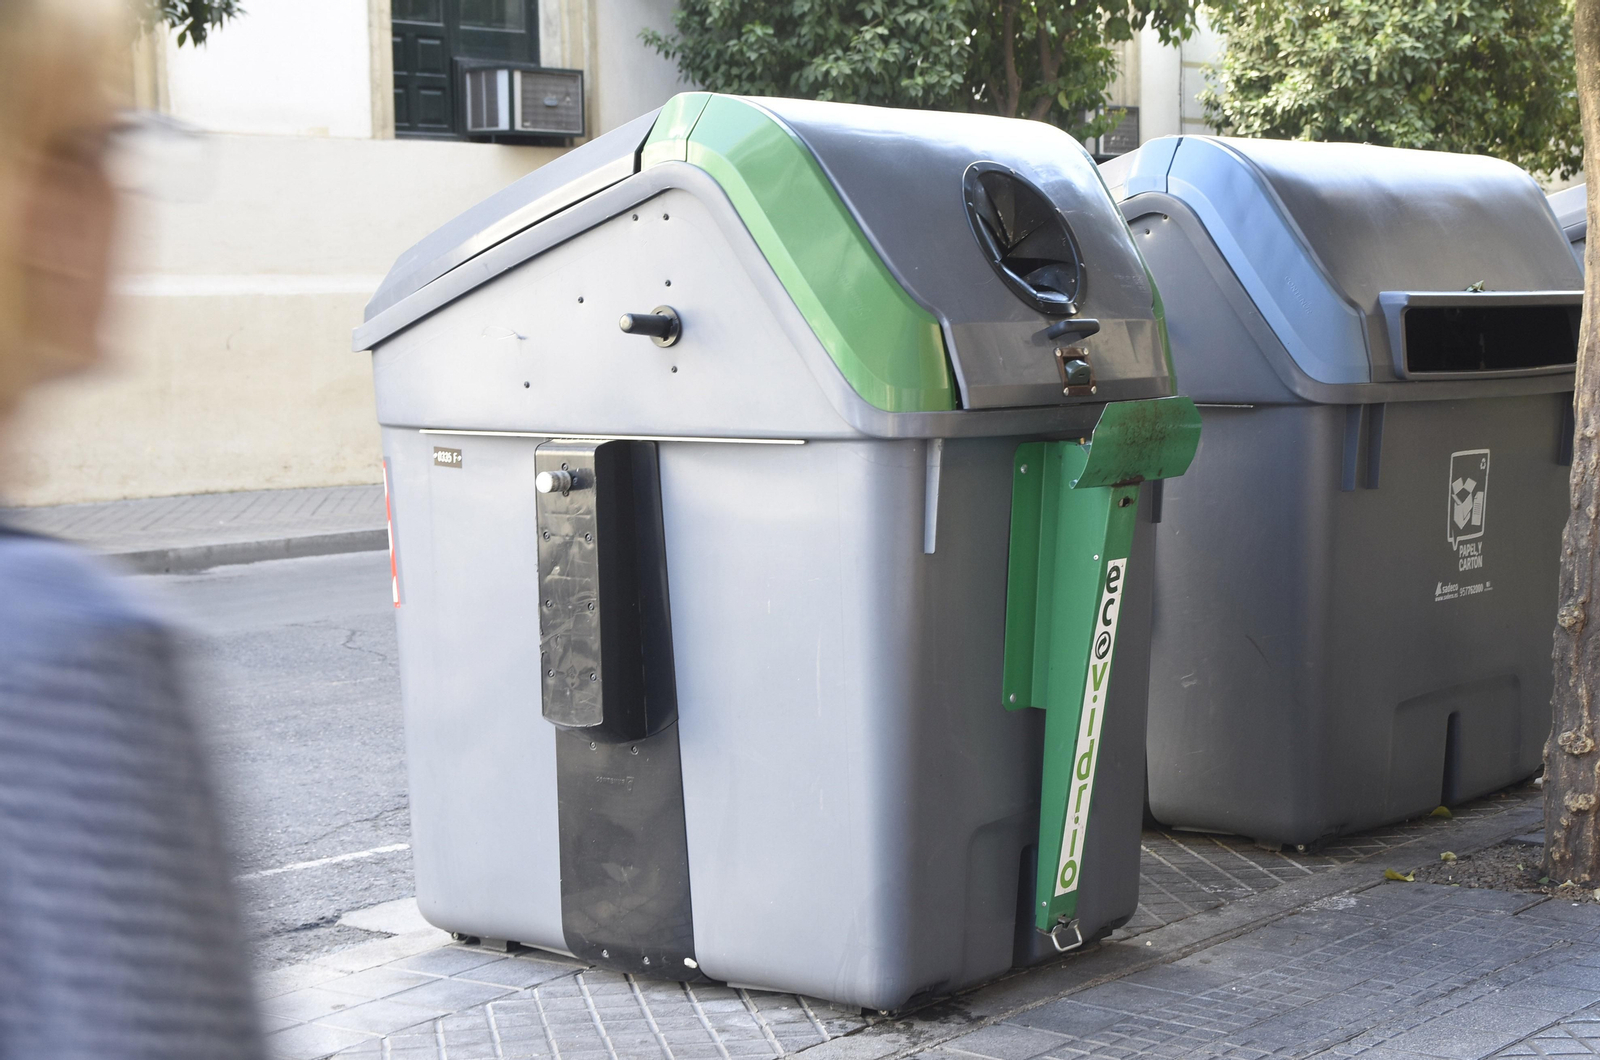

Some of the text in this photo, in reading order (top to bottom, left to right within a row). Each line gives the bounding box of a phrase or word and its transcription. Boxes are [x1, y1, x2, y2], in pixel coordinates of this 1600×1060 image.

[1459, 541, 1483, 558] PAPEL Y
[1059, 563, 1121, 889] ecovidrio
